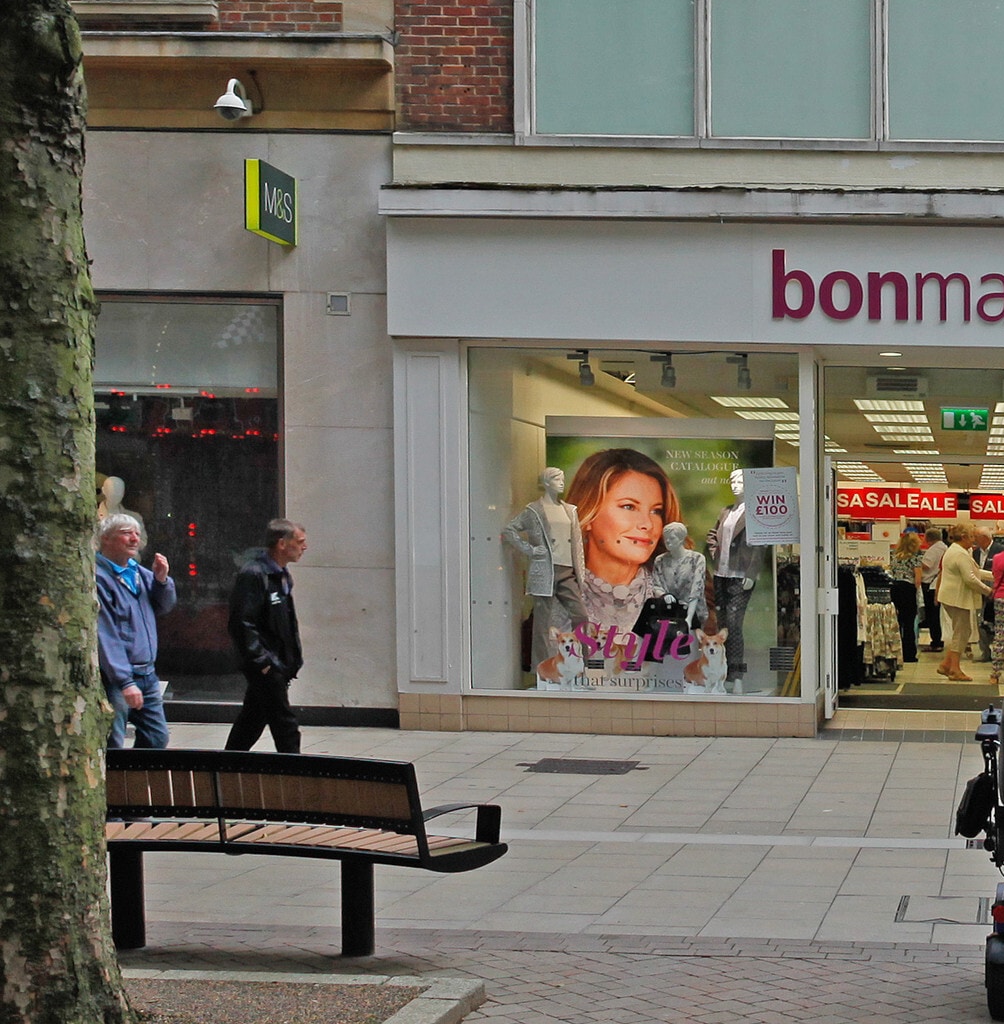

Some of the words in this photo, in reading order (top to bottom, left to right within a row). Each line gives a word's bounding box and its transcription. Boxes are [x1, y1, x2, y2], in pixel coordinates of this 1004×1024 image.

[264, 182, 293, 224] M&S
[666, 450, 691, 459] NEW
[694, 450, 739, 460] SEASON
[670, 462, 740, 472] CATALOGUE
[756, 495, 786, 505] WIN
[865, 492, 920, 508] SALE
[755, 505, 788, 515] £100
[568, 620, 695, 670] Style
[574, 674, 605, 687] that
